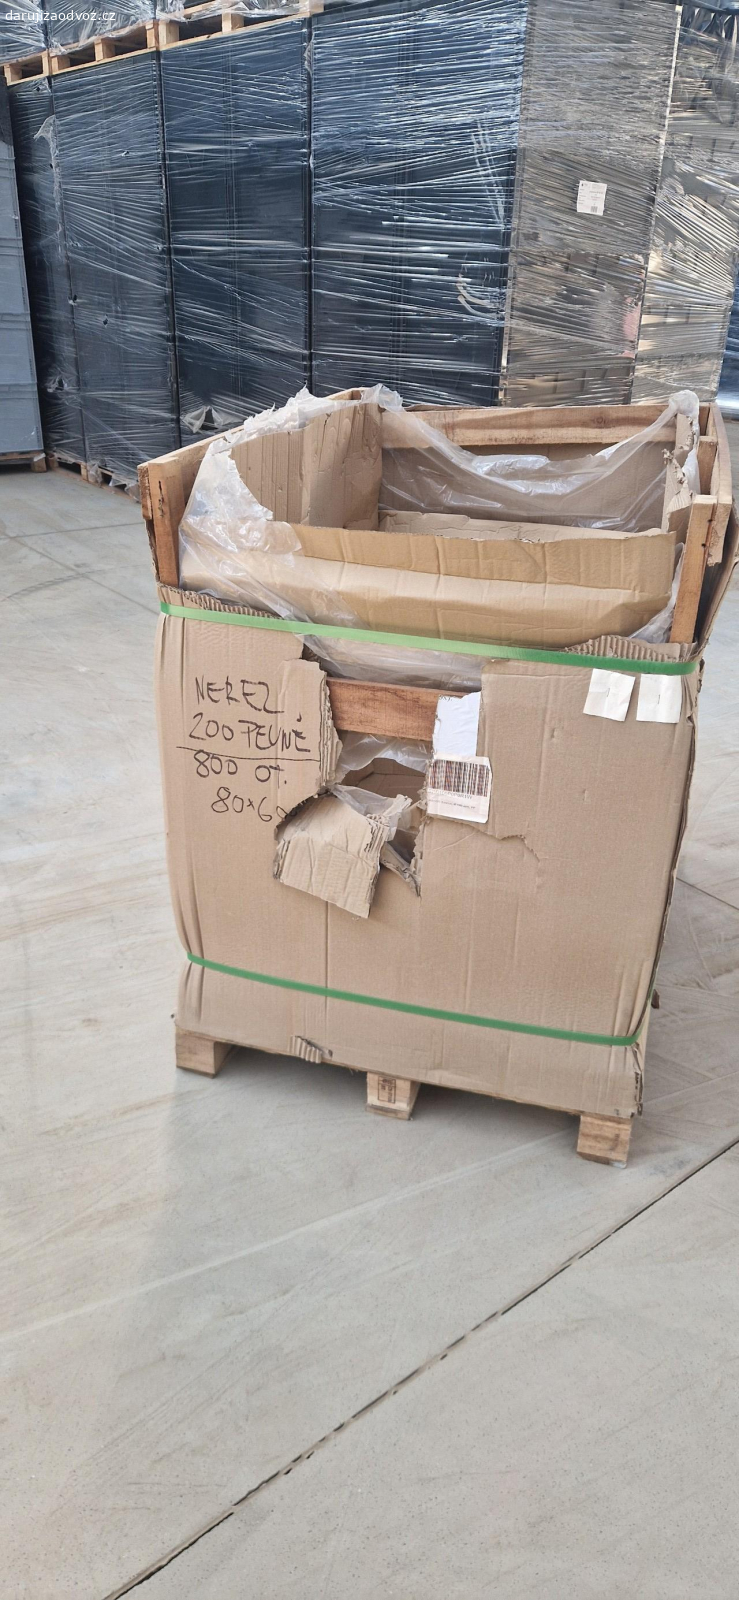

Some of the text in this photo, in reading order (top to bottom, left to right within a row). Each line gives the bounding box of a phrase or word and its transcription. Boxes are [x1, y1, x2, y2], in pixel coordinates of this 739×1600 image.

[195, 675, 285, 714] NEREZ
[188, 712, 234, 741] 200
[193, 749, 238, 778] 800
